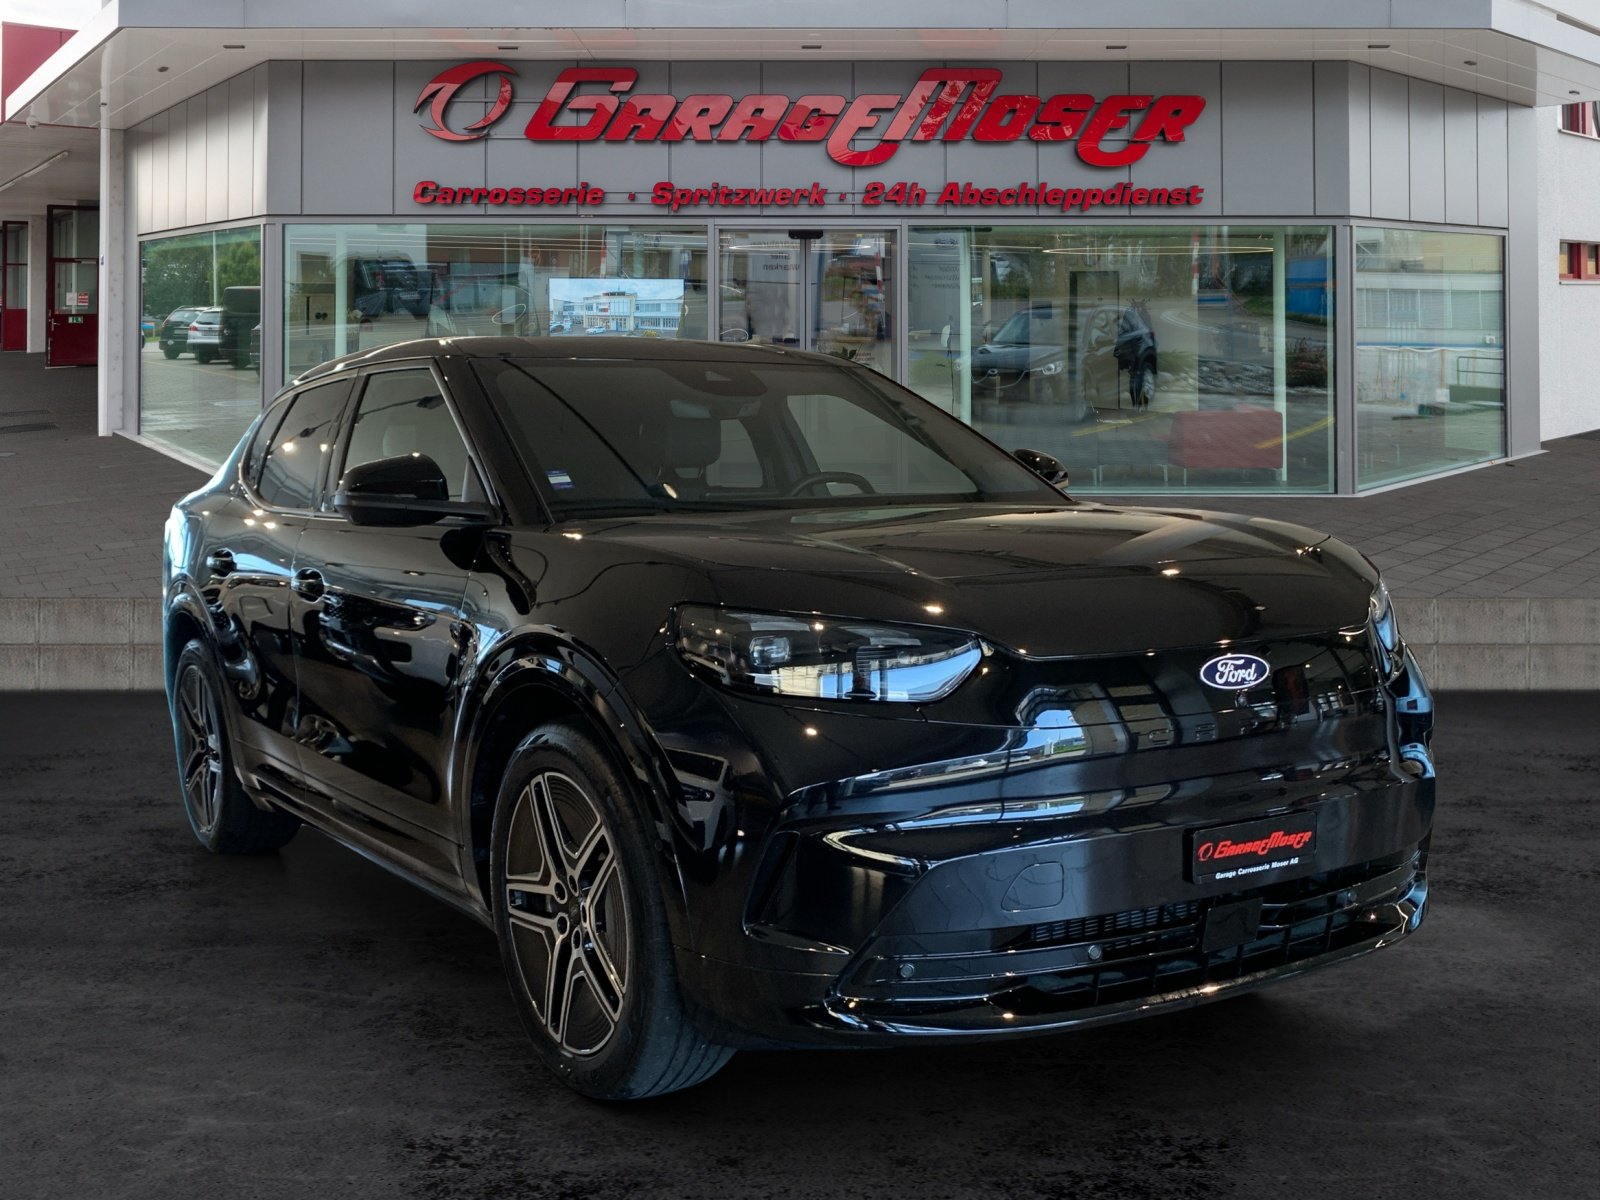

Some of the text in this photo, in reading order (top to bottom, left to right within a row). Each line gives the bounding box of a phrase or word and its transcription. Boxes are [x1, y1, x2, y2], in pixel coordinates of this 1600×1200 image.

[413, 180, 1205, 212] Carrosserie Spritzwerk 24h Abschleppdienst
[1215, 659, 1257, 684] Ford
[1215, 856, 1299, 880] Garage Carrosserie Moser AG
